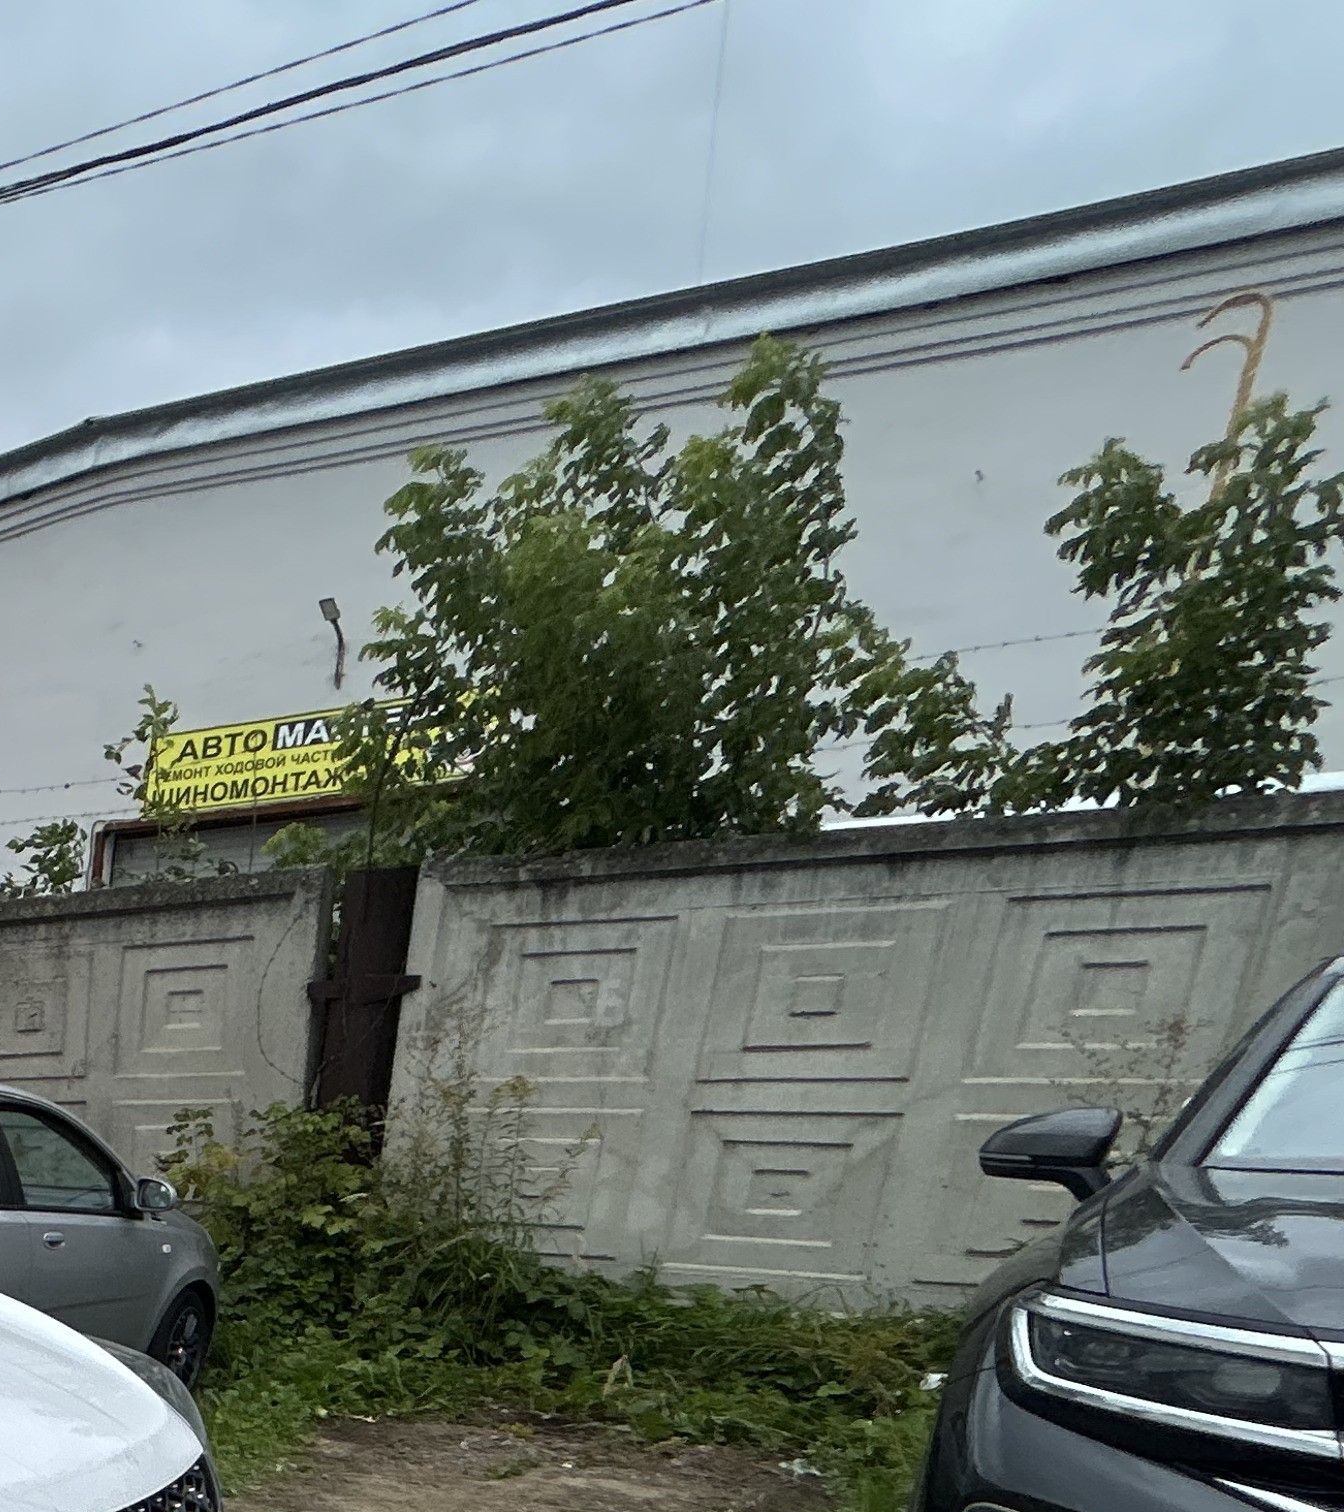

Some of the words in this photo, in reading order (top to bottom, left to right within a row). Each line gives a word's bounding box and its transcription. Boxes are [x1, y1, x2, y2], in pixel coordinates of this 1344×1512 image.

[174, 729, 268, 763] АВТО
[214, 754, 286, 776] ХОДОВОЙ
[152, 766, 345, 805] ШИНОМОНТАЖ
